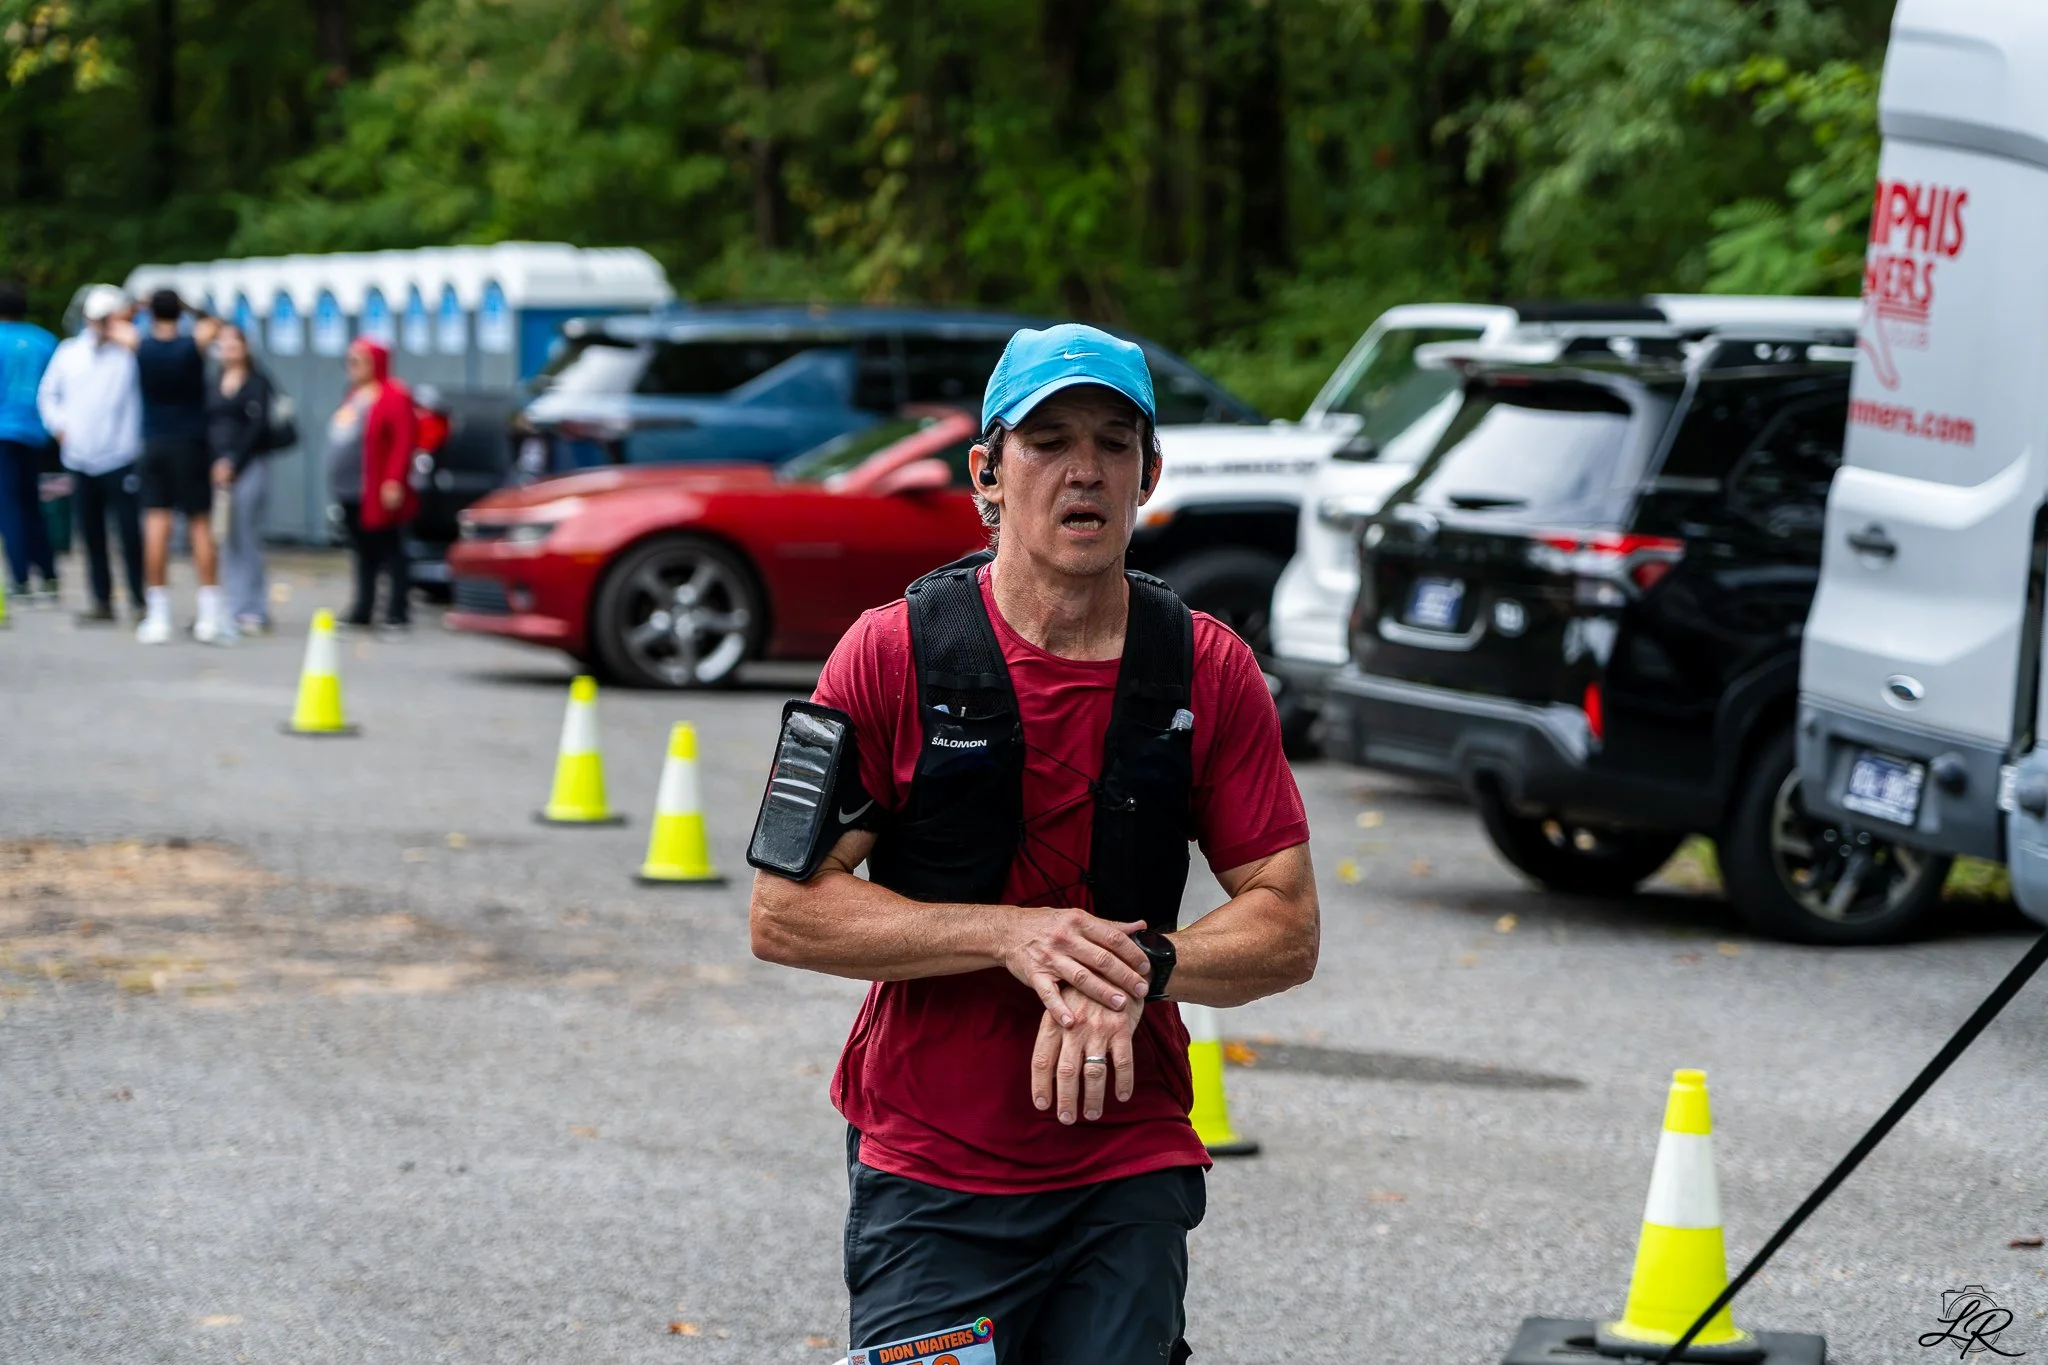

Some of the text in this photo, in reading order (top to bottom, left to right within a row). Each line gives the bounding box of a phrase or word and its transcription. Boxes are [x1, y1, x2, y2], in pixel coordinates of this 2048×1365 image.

[931, 737, 987, 748] SALOMON
[879, 1343, 915, 1364] DION
[915, 1330, 974, 1354] WAITERS
